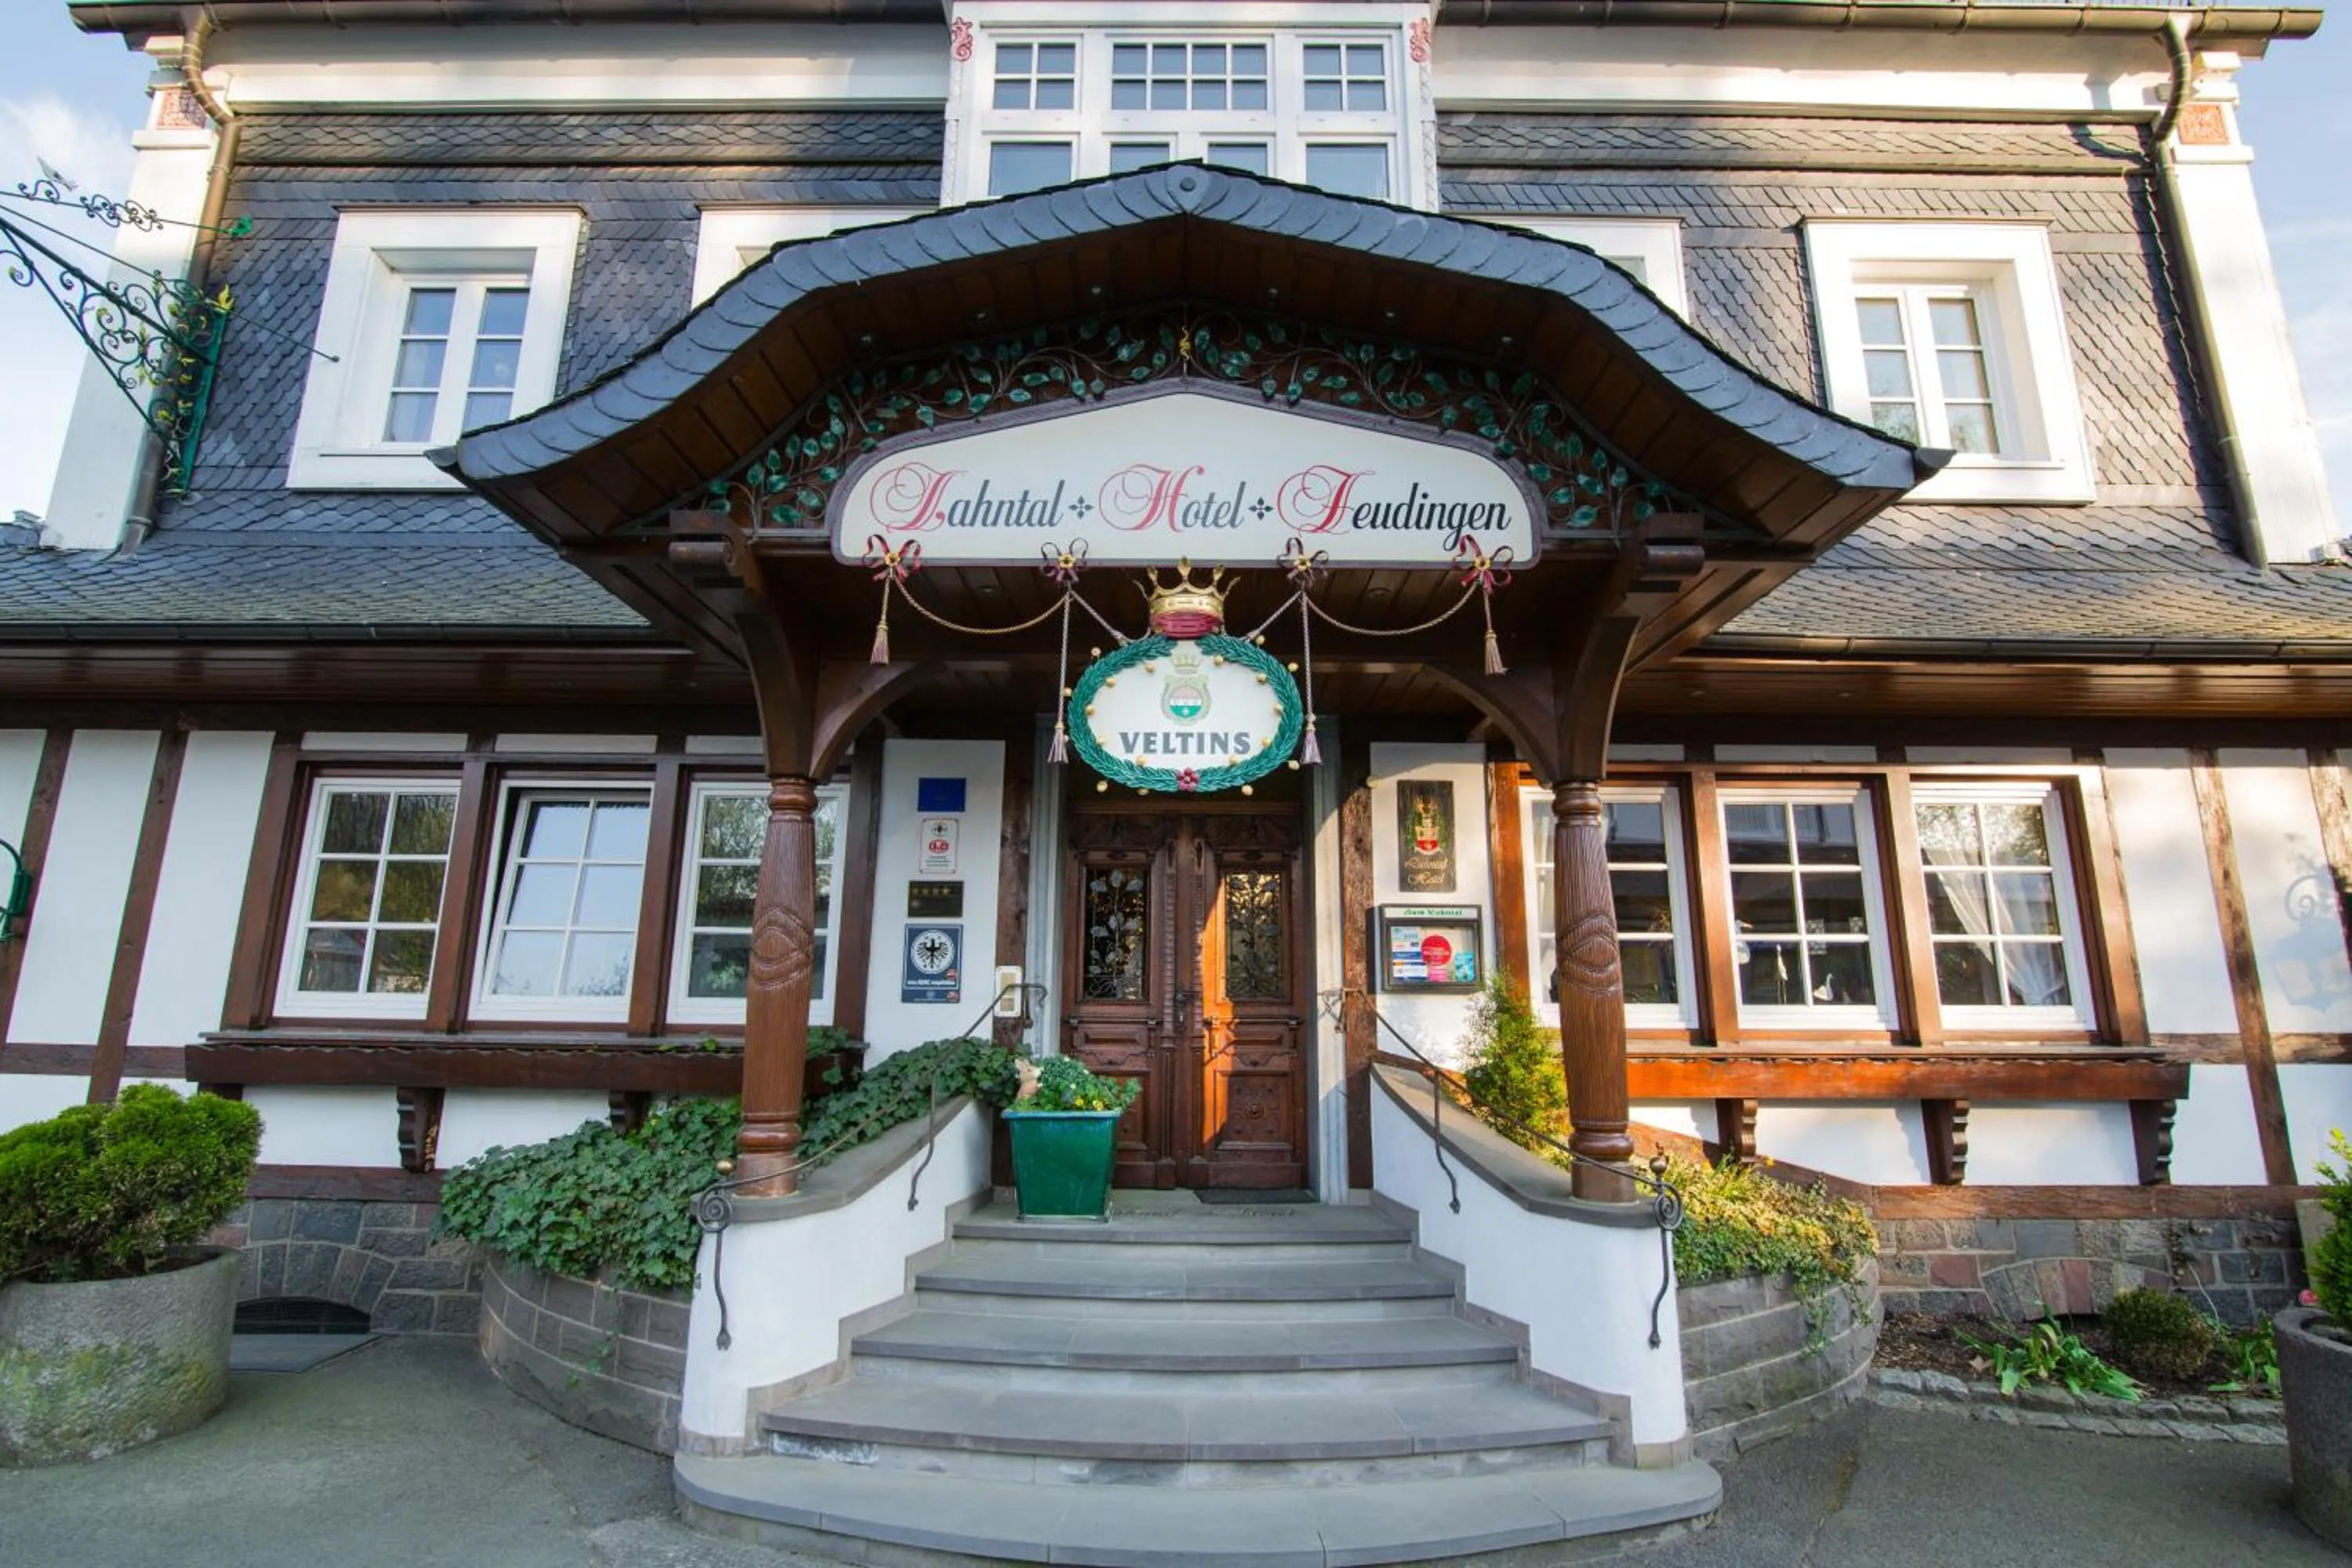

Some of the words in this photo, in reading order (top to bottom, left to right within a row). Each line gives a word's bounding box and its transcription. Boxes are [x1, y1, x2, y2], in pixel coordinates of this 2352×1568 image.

[869, 462, 1065, 533] Lahntal
[1098, 464, 1247, 533] Hotel
[1277, 465, 1512, 551] Feudingen
[1119, 731, 1251, 755] VELTINS
